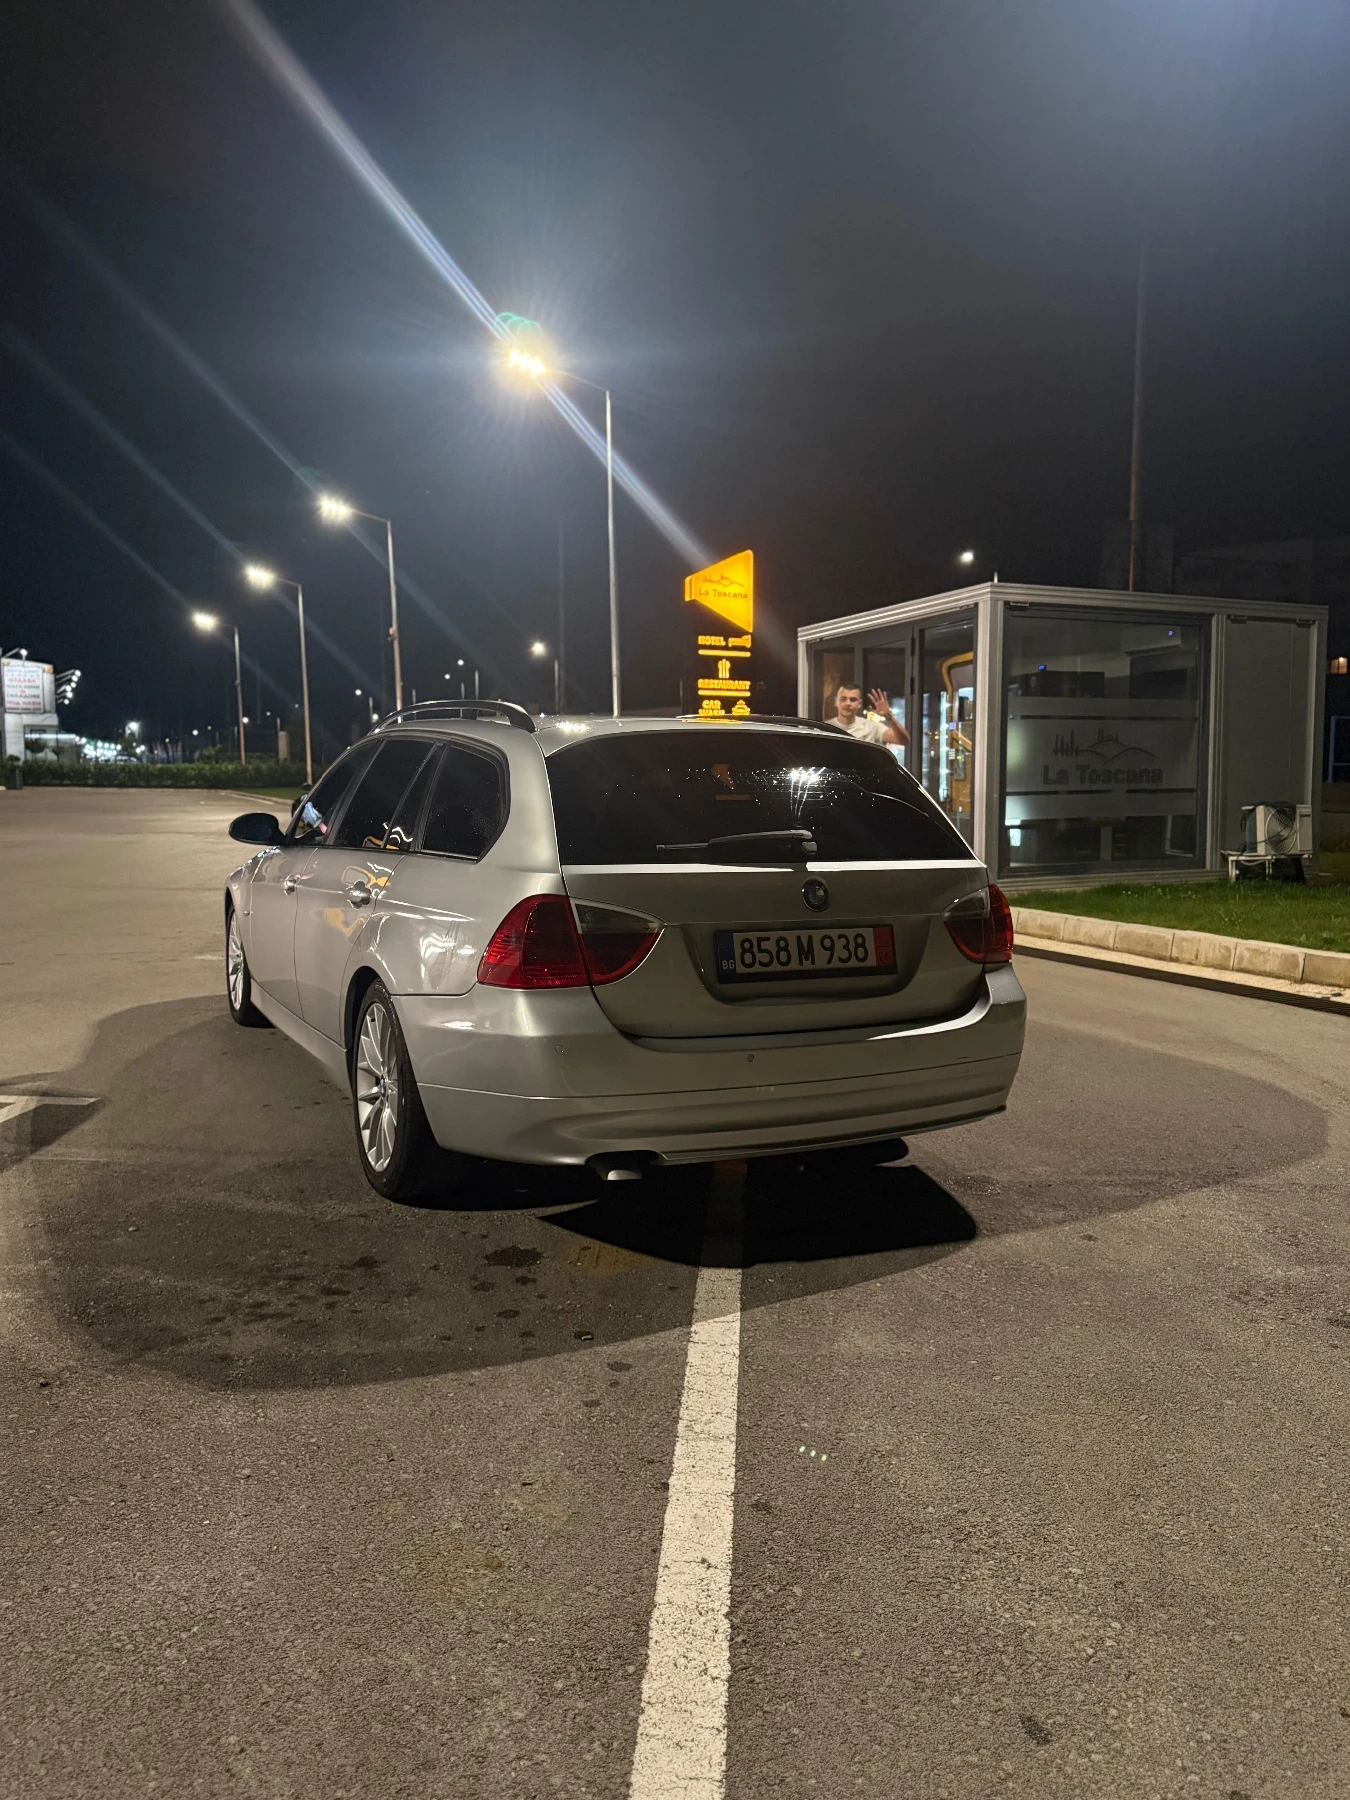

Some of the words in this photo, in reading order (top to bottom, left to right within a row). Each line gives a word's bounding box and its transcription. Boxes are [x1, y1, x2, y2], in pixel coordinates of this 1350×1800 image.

[699, 588, 710, 596] La
[712, 589, 748, 599] Toscana
[698, 635, 726, 646] HOTEL
[698, 678, 751, 690] RESTAURANT
[702, 699, 721, 709] CAR
[698, 708, 726, 716] WASH
[1043, 764, 1069, 785] La
[1076, 764, 1163, 784] Toscana
[740, 936, 792, 969] 858
[796, 935, 816, 966] M
[820, 933, 869, 965] 938
[722, 960, 735, 970] BG
